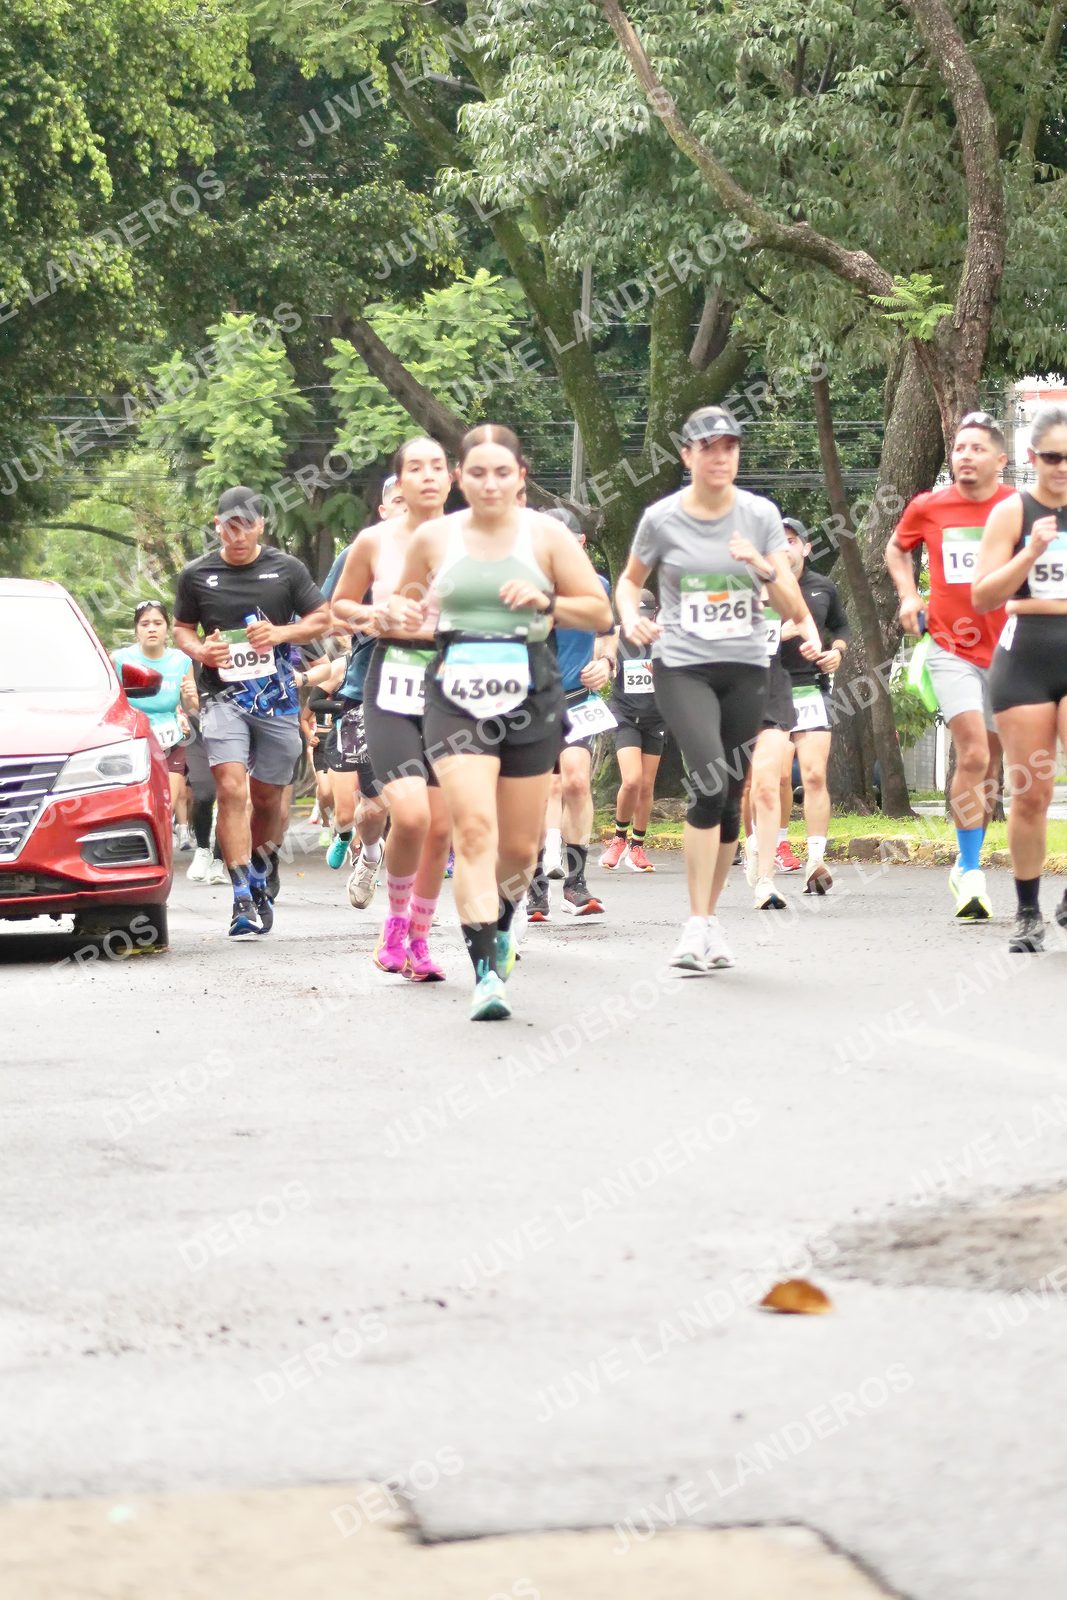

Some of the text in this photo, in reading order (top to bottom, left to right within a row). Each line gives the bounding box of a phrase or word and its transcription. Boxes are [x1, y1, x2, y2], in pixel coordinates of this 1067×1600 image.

[1034, 562, 1067, 582] 55
[689, 600, 747, 623] 1926
[451, 678, 522, 700] 4300
[627, 674, 652, 686] 320
